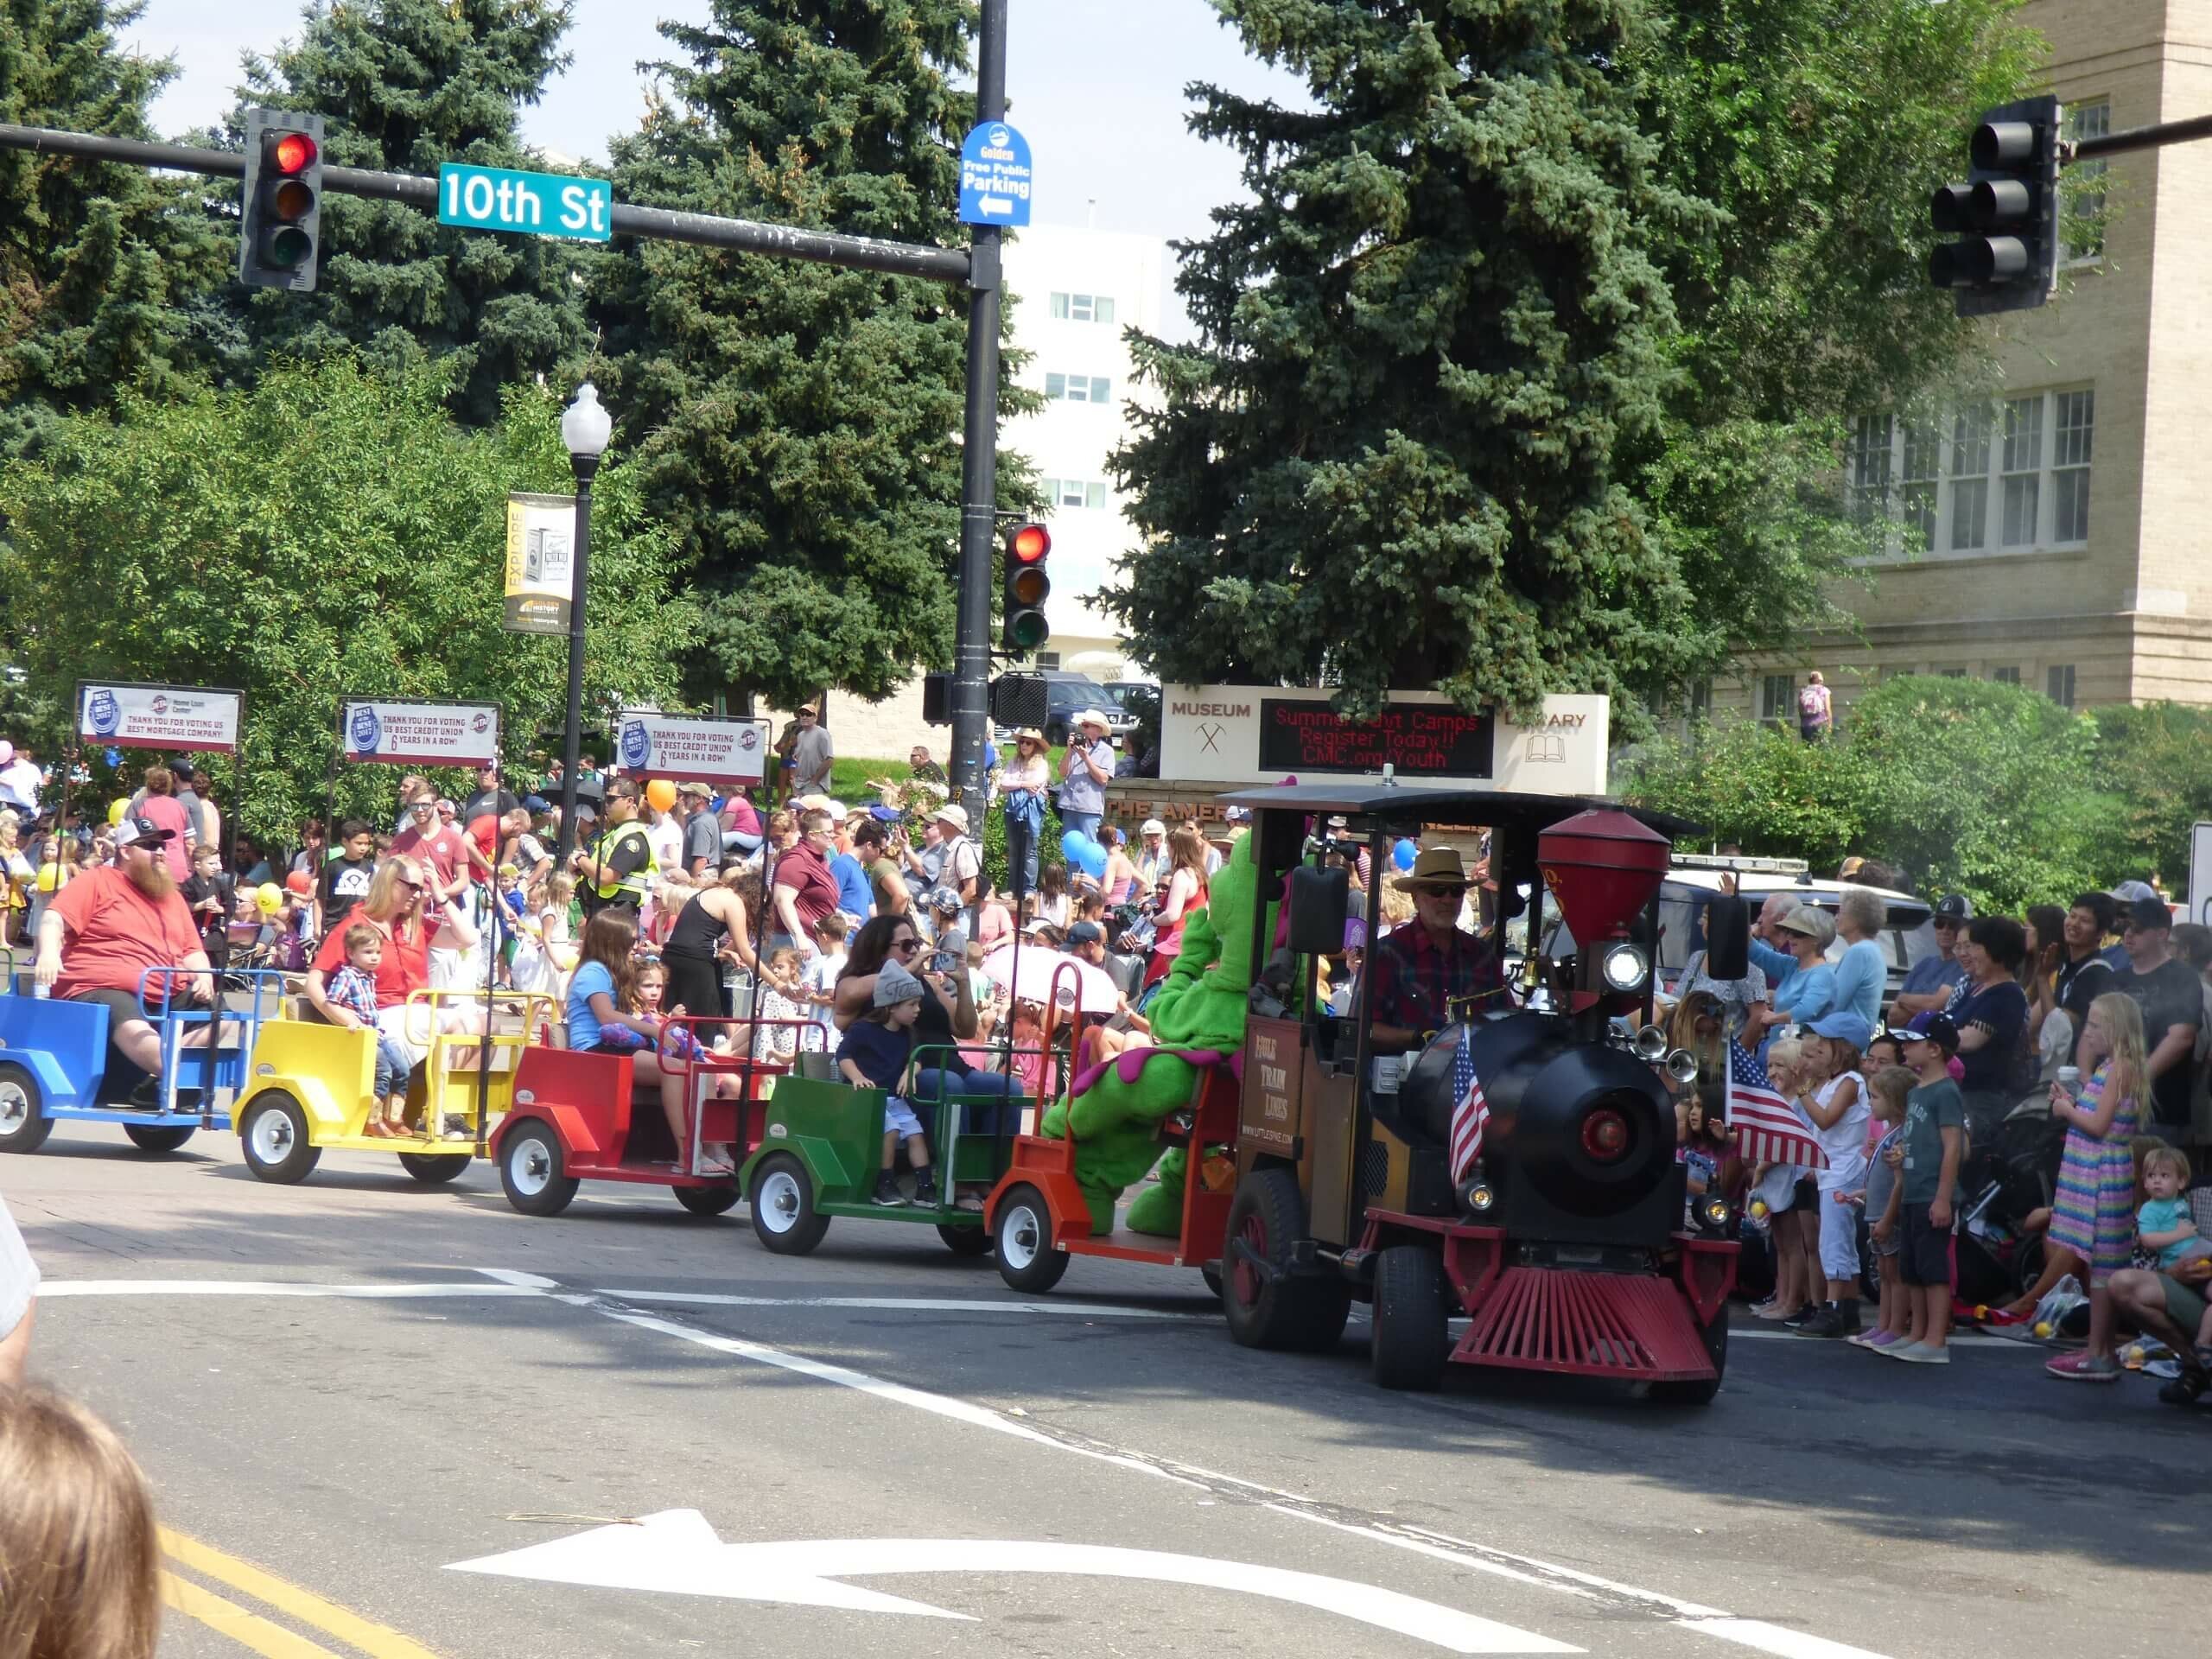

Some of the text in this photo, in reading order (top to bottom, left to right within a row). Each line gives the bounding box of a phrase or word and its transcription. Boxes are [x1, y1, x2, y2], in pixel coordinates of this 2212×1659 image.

[981, 146, 1014, 161] Golden
[963, 160, 1030, 176] Free Public
[963, 172, 1030, 200] Parking
[446, 173, 605, 232] 10th St
[510, 512, 523, 588] EXPLORE
[1172, 702, 1251, 717] MUSEUM
[128, 715, 152, 724] THANK
[154, 717, 168, 726] YOU
[170, 718, 184, 727] FOR
[187, 719, 213, 728] VOTING
[384, 715, 407, 724] THANK
[409, 716, 422, 725] YOU
[440, 718, 466, 727] VOTING
[1412, 711, 1478, 734] Camps
[126, 725, 144, 734] BEST
[146, 727, 186, 736] MORTGAGE
[384, 725, 464, 736] US BEST CREDIT UNION
[652, 730, 676, 740] THANK
[677, 732, 690, 741] YOU
[692, 733, 706, 741] FOR
[708, 734, 734, 742] VOTING
[391, 735, 397, 751] 6
[399, 736, 421, 745] YEARS
[423, 736, 430, 745] IN
[440, 737, 457, 746] ROW!
[653, 741, 732, 753] US BEST CREDIT UNION
[1300, 727, 1455, 751] Register Today!!
[660, 751, 666, 768] 6
[668, 752, 690, 761] YEARS
[691, 753, 699, 761] IN
[708, 753, 725, 763] ROW!
[1107, 801, 1151, 817] THE
[1261, 1064, 1286, 1091] TRAIN
[1264, 1094, 1287, 1121] LINES
